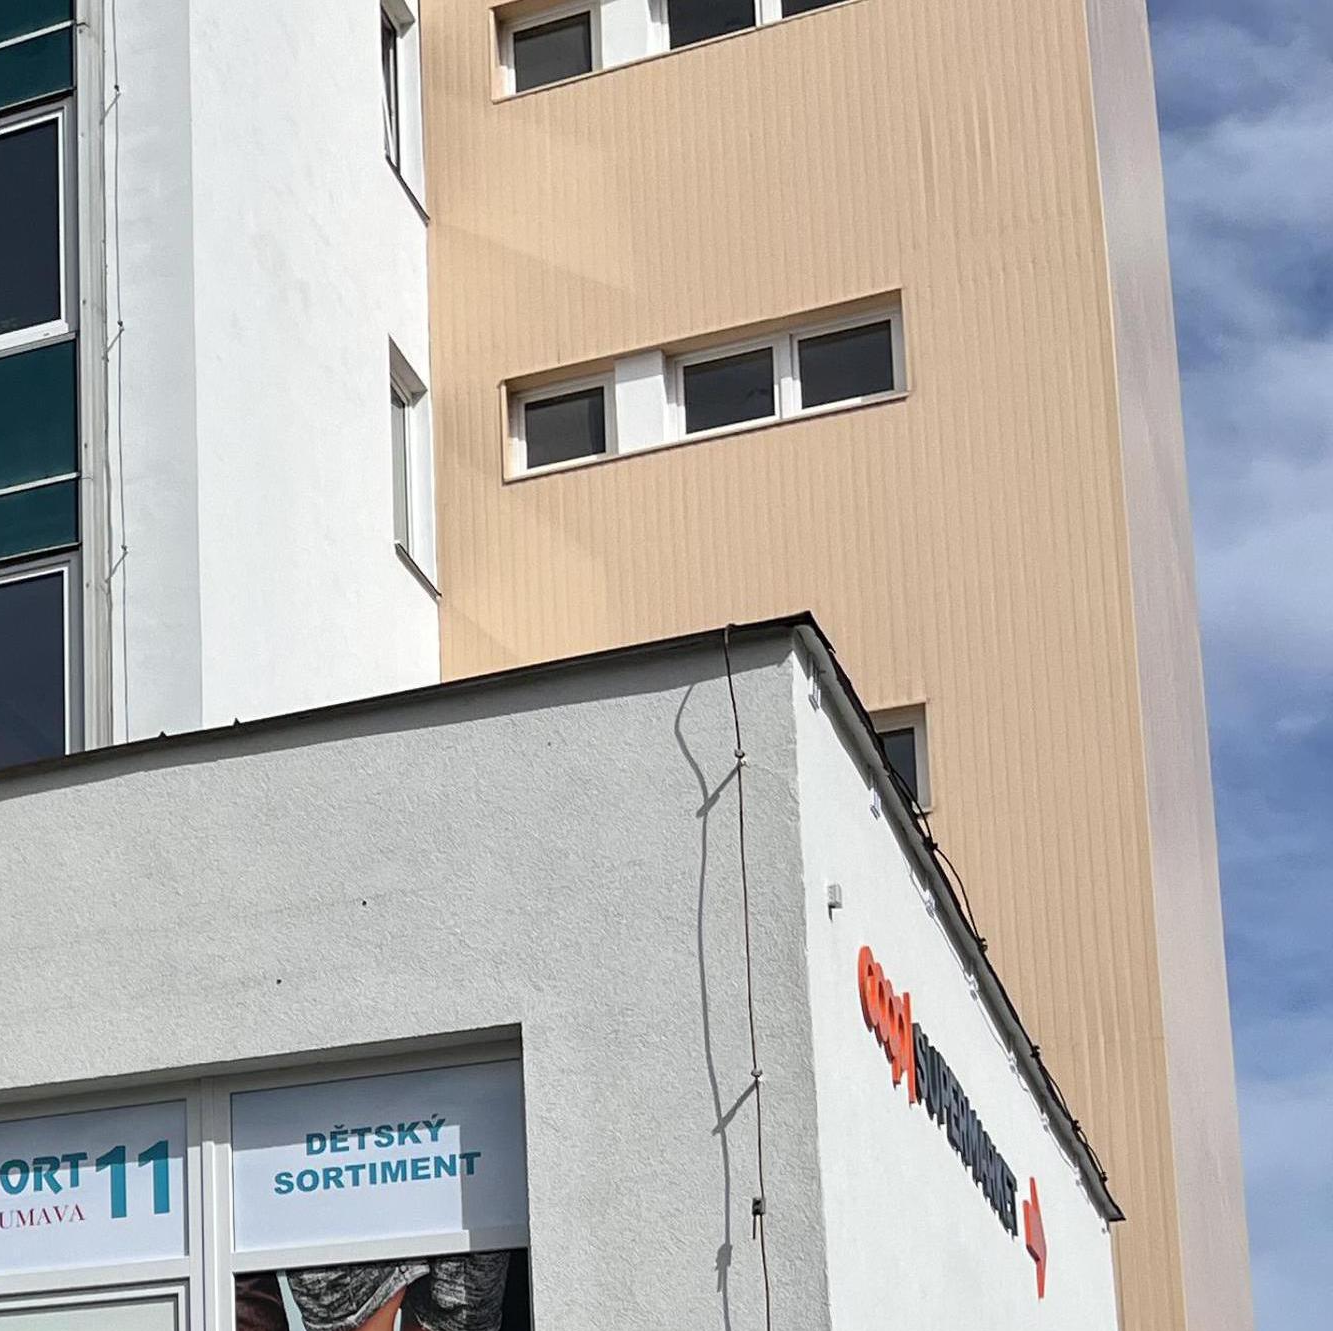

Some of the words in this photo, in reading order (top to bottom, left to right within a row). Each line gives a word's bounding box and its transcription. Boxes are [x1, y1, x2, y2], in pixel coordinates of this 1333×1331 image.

[306, 1112, 446, 1157] DĚTSKÝ
[95, 1139, 171, 1220] 11
[274, 1150, 483, 1195] SORTIMENT
